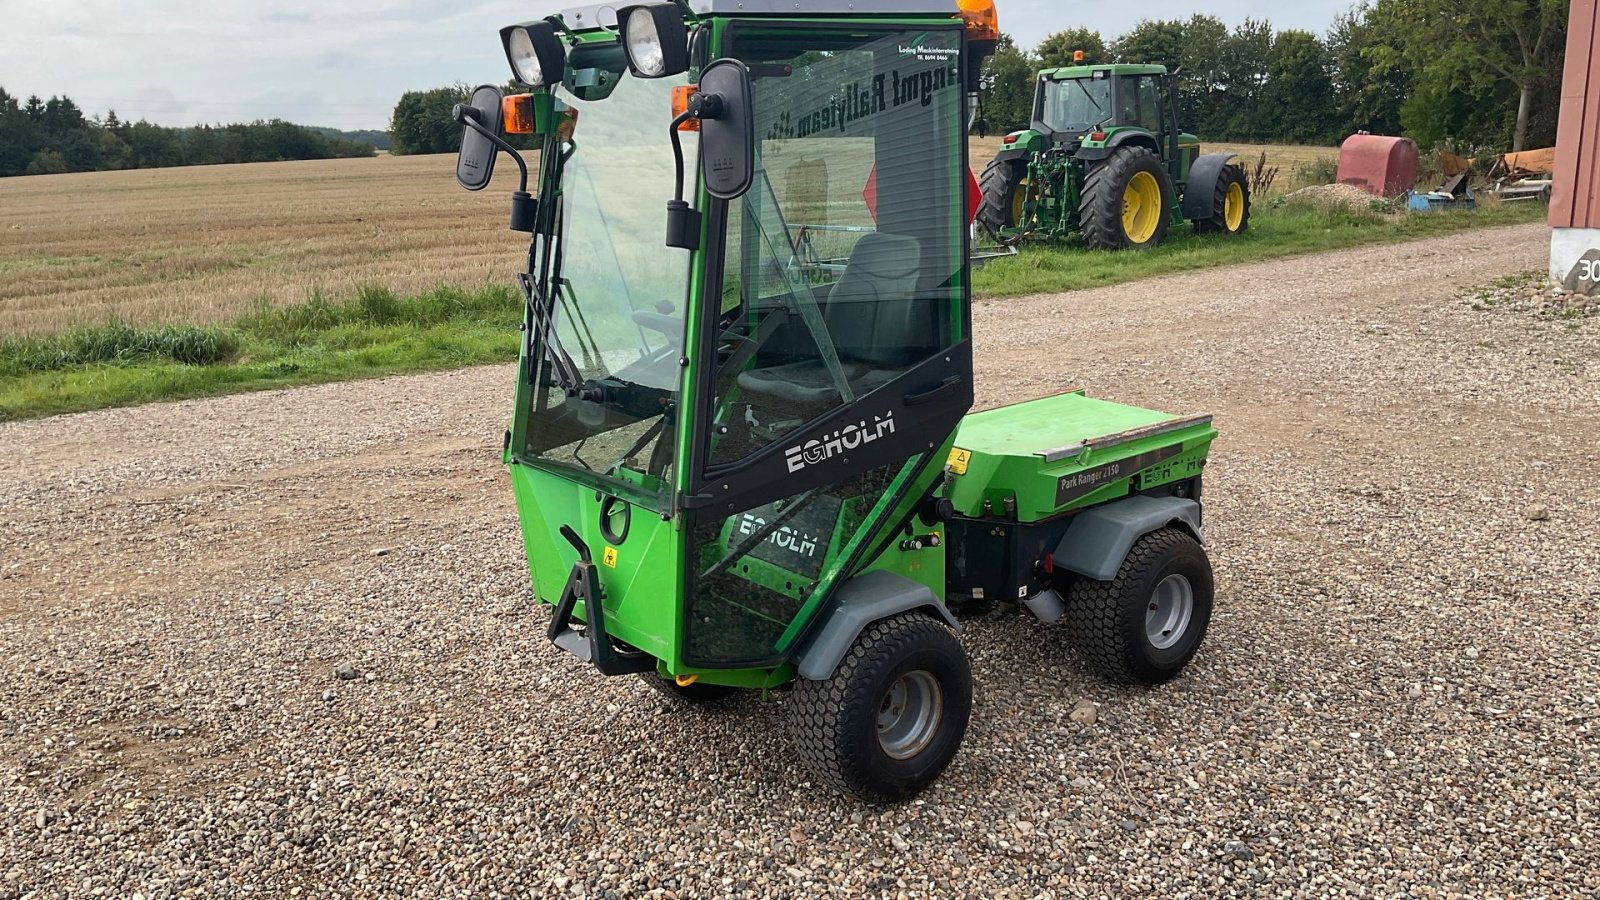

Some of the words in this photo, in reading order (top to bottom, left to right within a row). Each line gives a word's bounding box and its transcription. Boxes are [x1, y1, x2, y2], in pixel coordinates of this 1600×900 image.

[1579, 259, 1600, 282] 30
[785, 410, 896, 473] EGHOLM
[1061, 475, 1077, 490] Park
[1078, 470, 1102, 485] Ranger
[1103, 463, 1120, 478] 2150
